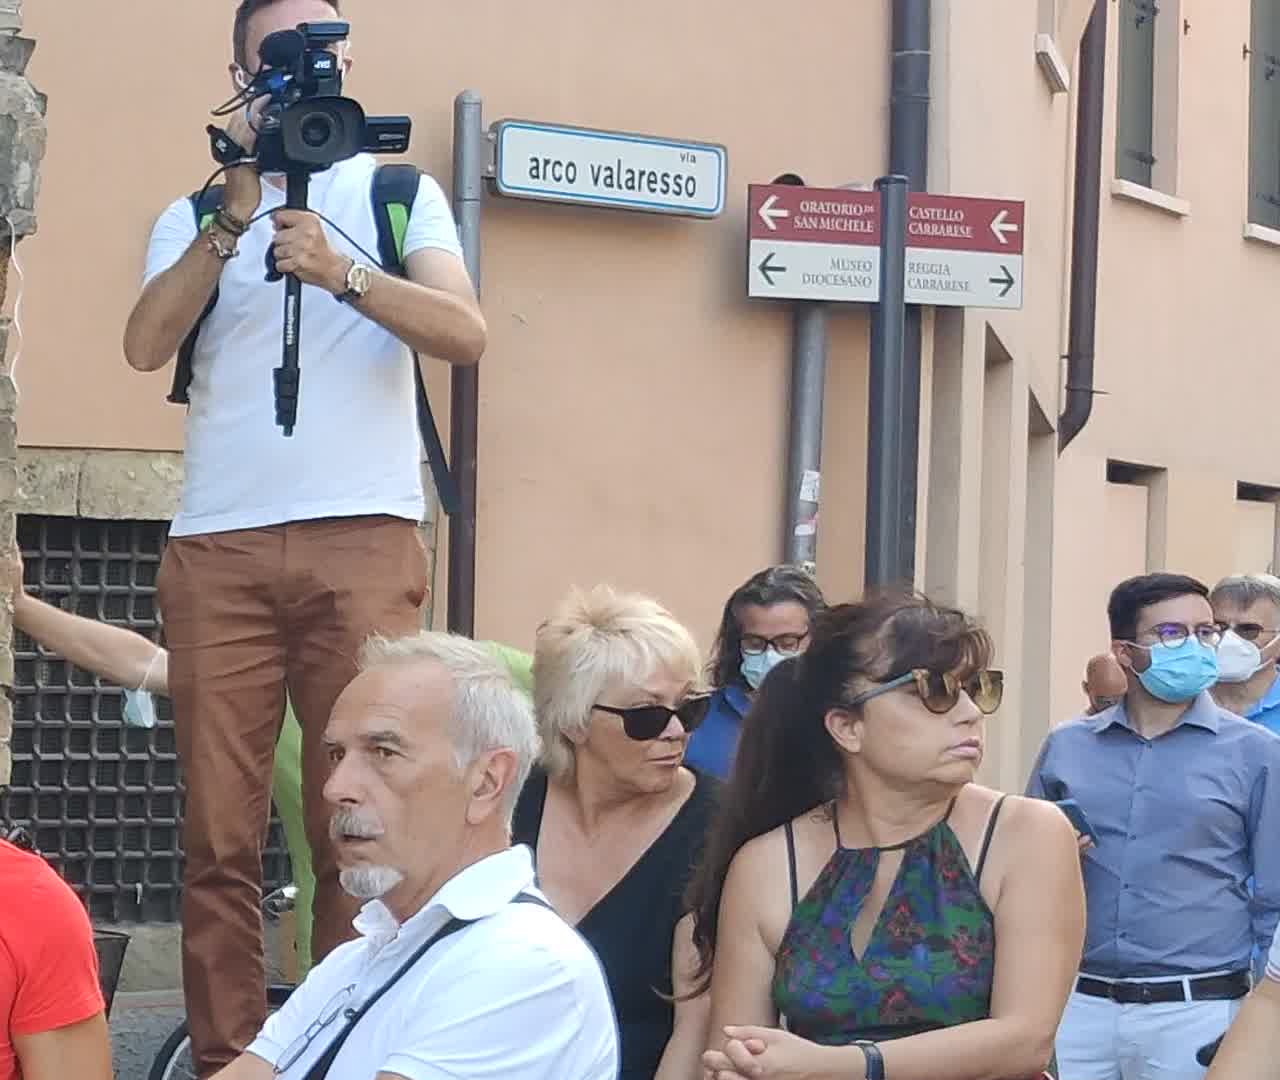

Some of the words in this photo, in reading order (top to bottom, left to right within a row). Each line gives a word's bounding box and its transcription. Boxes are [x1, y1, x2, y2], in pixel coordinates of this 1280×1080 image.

[680, 152, 697, 164] via
[528, 156, 577, 184] arco
[590, 159, 697, 198] valaresso
[800, 200, 863, 217] ORATORIO
[909, 206, 964, 222] CASTELLO
[793, 216, 818, 230] SAN
[819, 217, 874, 233] MICHELE
[908, 222, 973, 238] CARRARESE
[830, 257, 872, 272] MUSEO
[908, 262, 951, 276] REGGIA
[801, 273, 872, 289] DIOCESANO
[907, 278, 970, 292] CARRARESE
